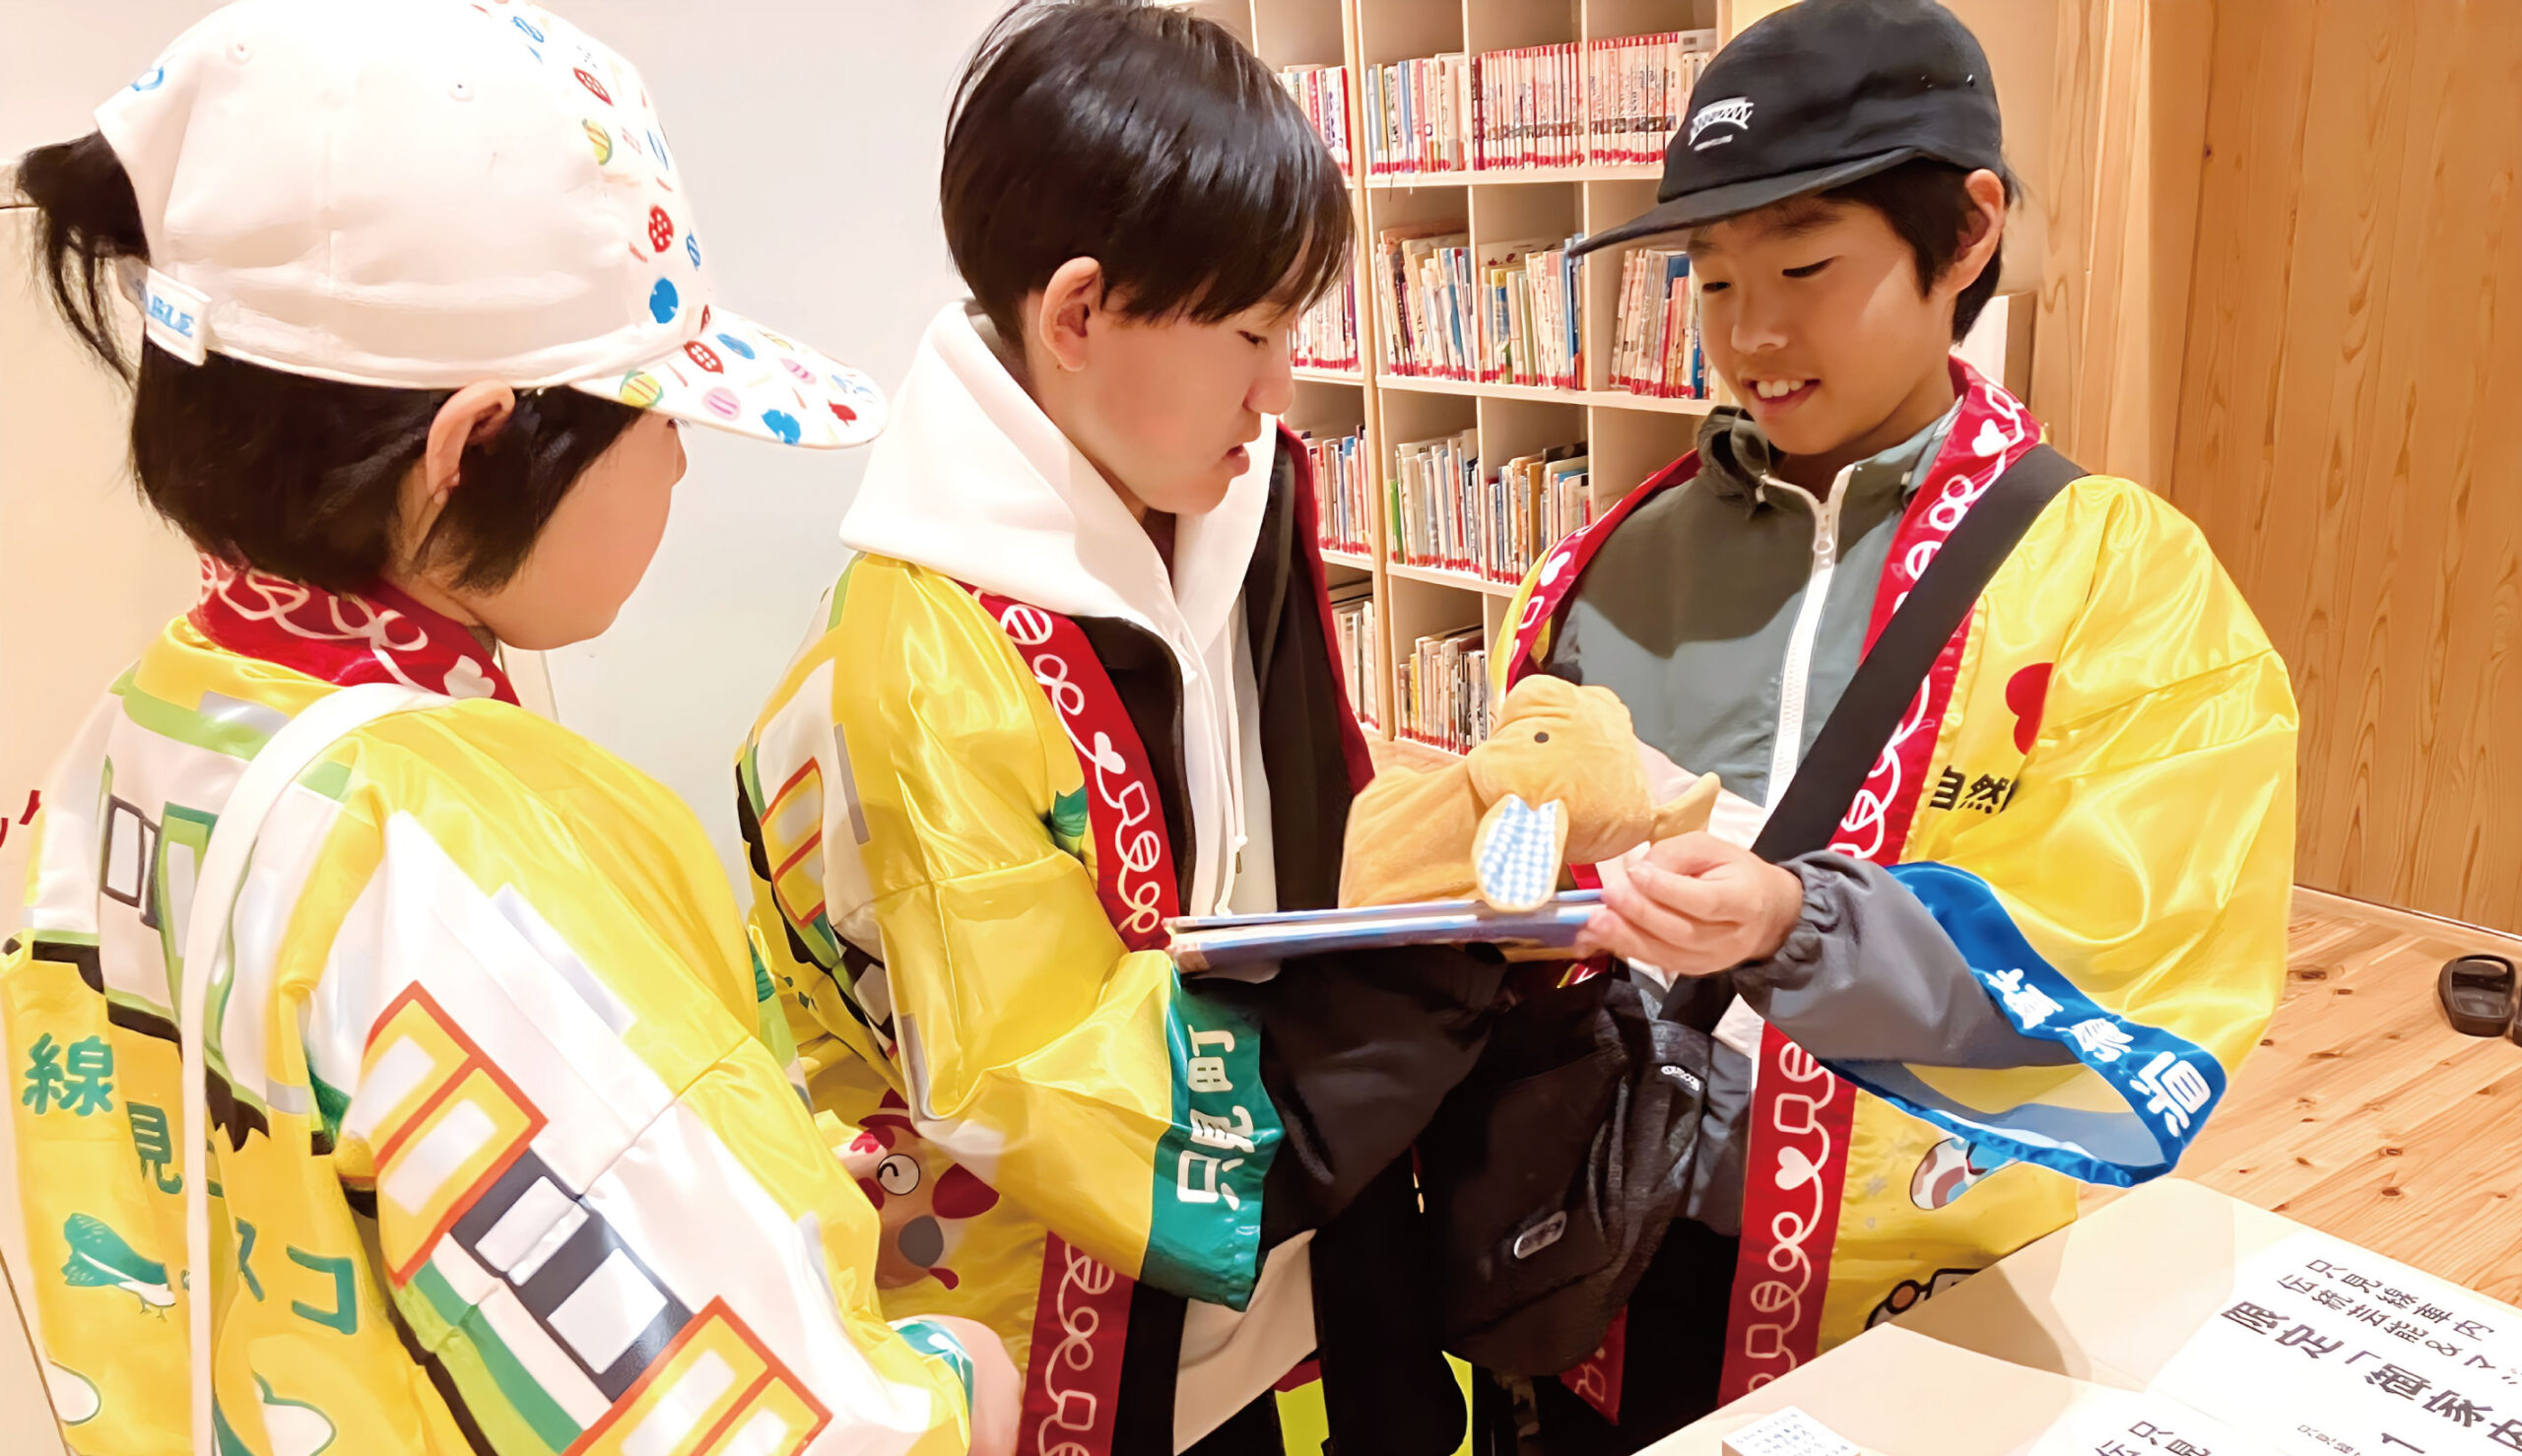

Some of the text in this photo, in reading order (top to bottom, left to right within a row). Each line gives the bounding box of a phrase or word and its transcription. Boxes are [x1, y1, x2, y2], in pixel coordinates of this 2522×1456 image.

[1929, 764, 2020, 814] 自然
[1985, 968, 2211, 1137] 福島県
[1177, 1025, 1255, 1211] 只見町
[2305, 1259, 2495, 1341] 只見線車内
